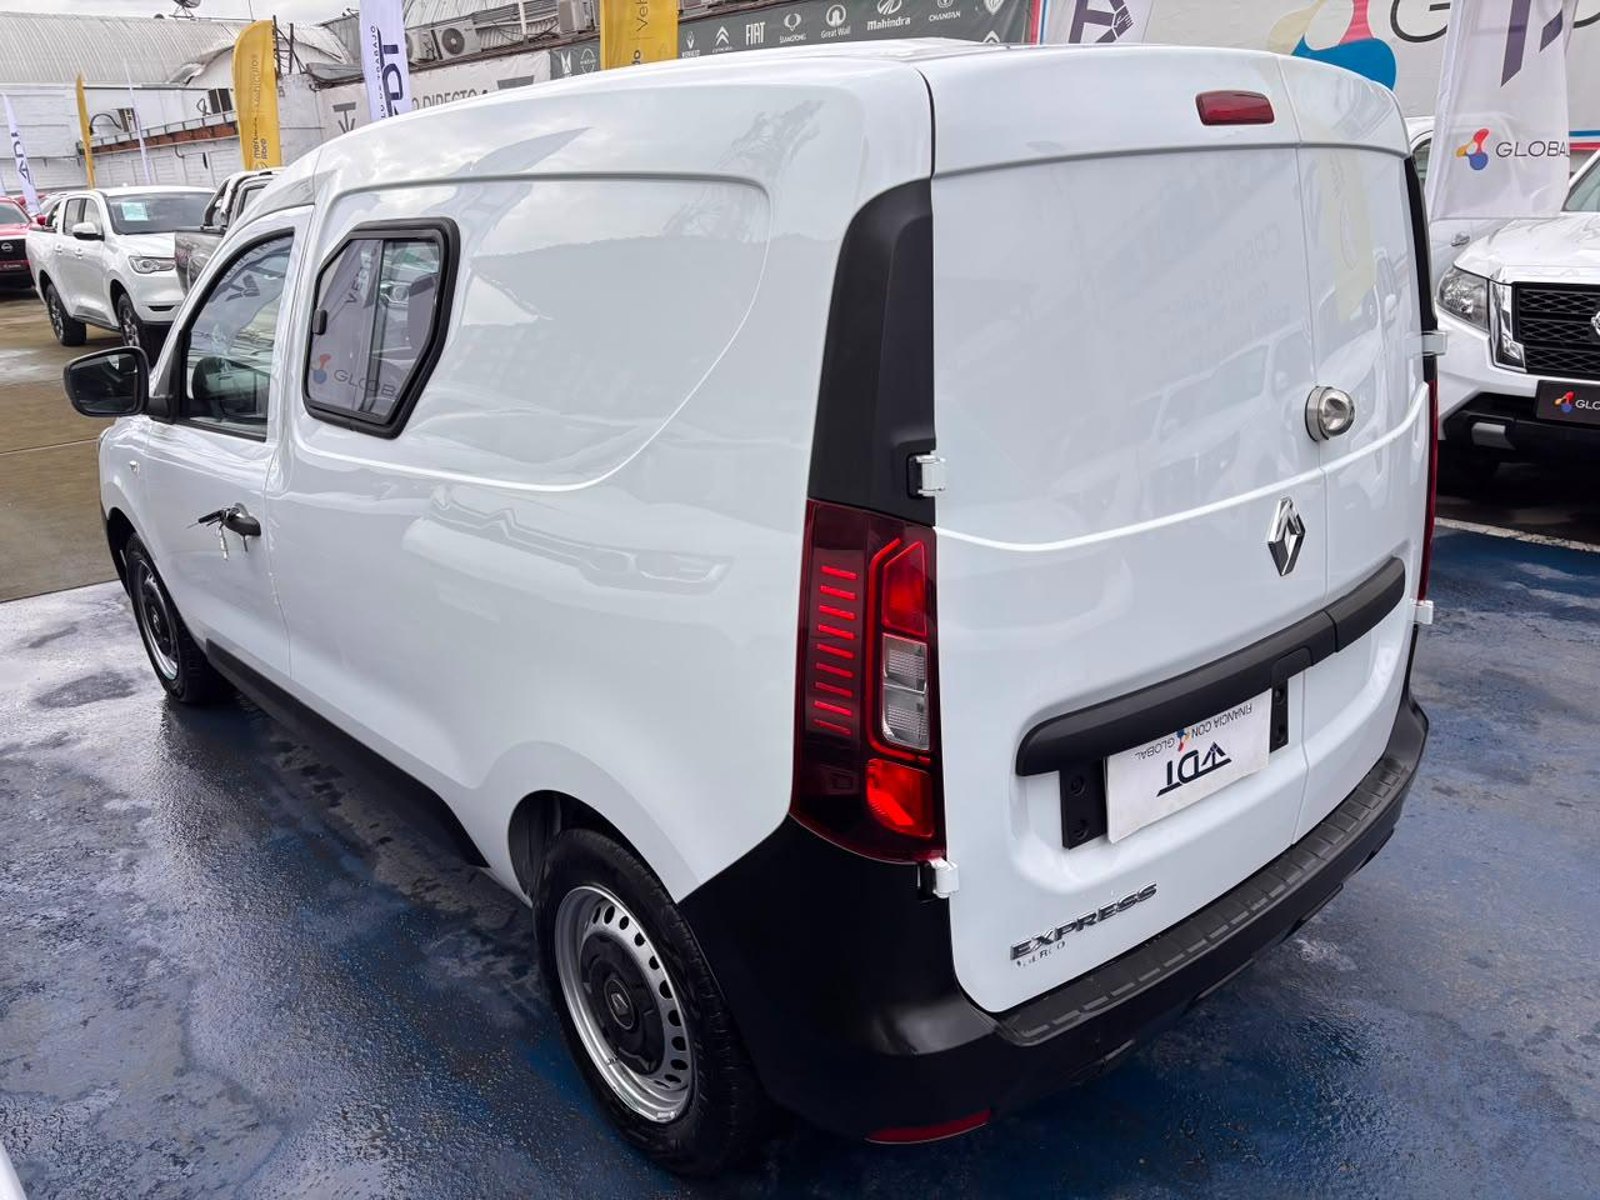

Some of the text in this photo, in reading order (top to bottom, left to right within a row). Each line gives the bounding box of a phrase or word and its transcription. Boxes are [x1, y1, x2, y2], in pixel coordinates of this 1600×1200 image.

[745, 22, 766, 46] FIAT
[820, 25, 851, 39] Great Wall
[866, 16, 911, 31] Mahindra
[1134, 703, 1254, 762] FINANCIA CON GLOBAL
[1010, 880, 1158, 961] EXPRESS
